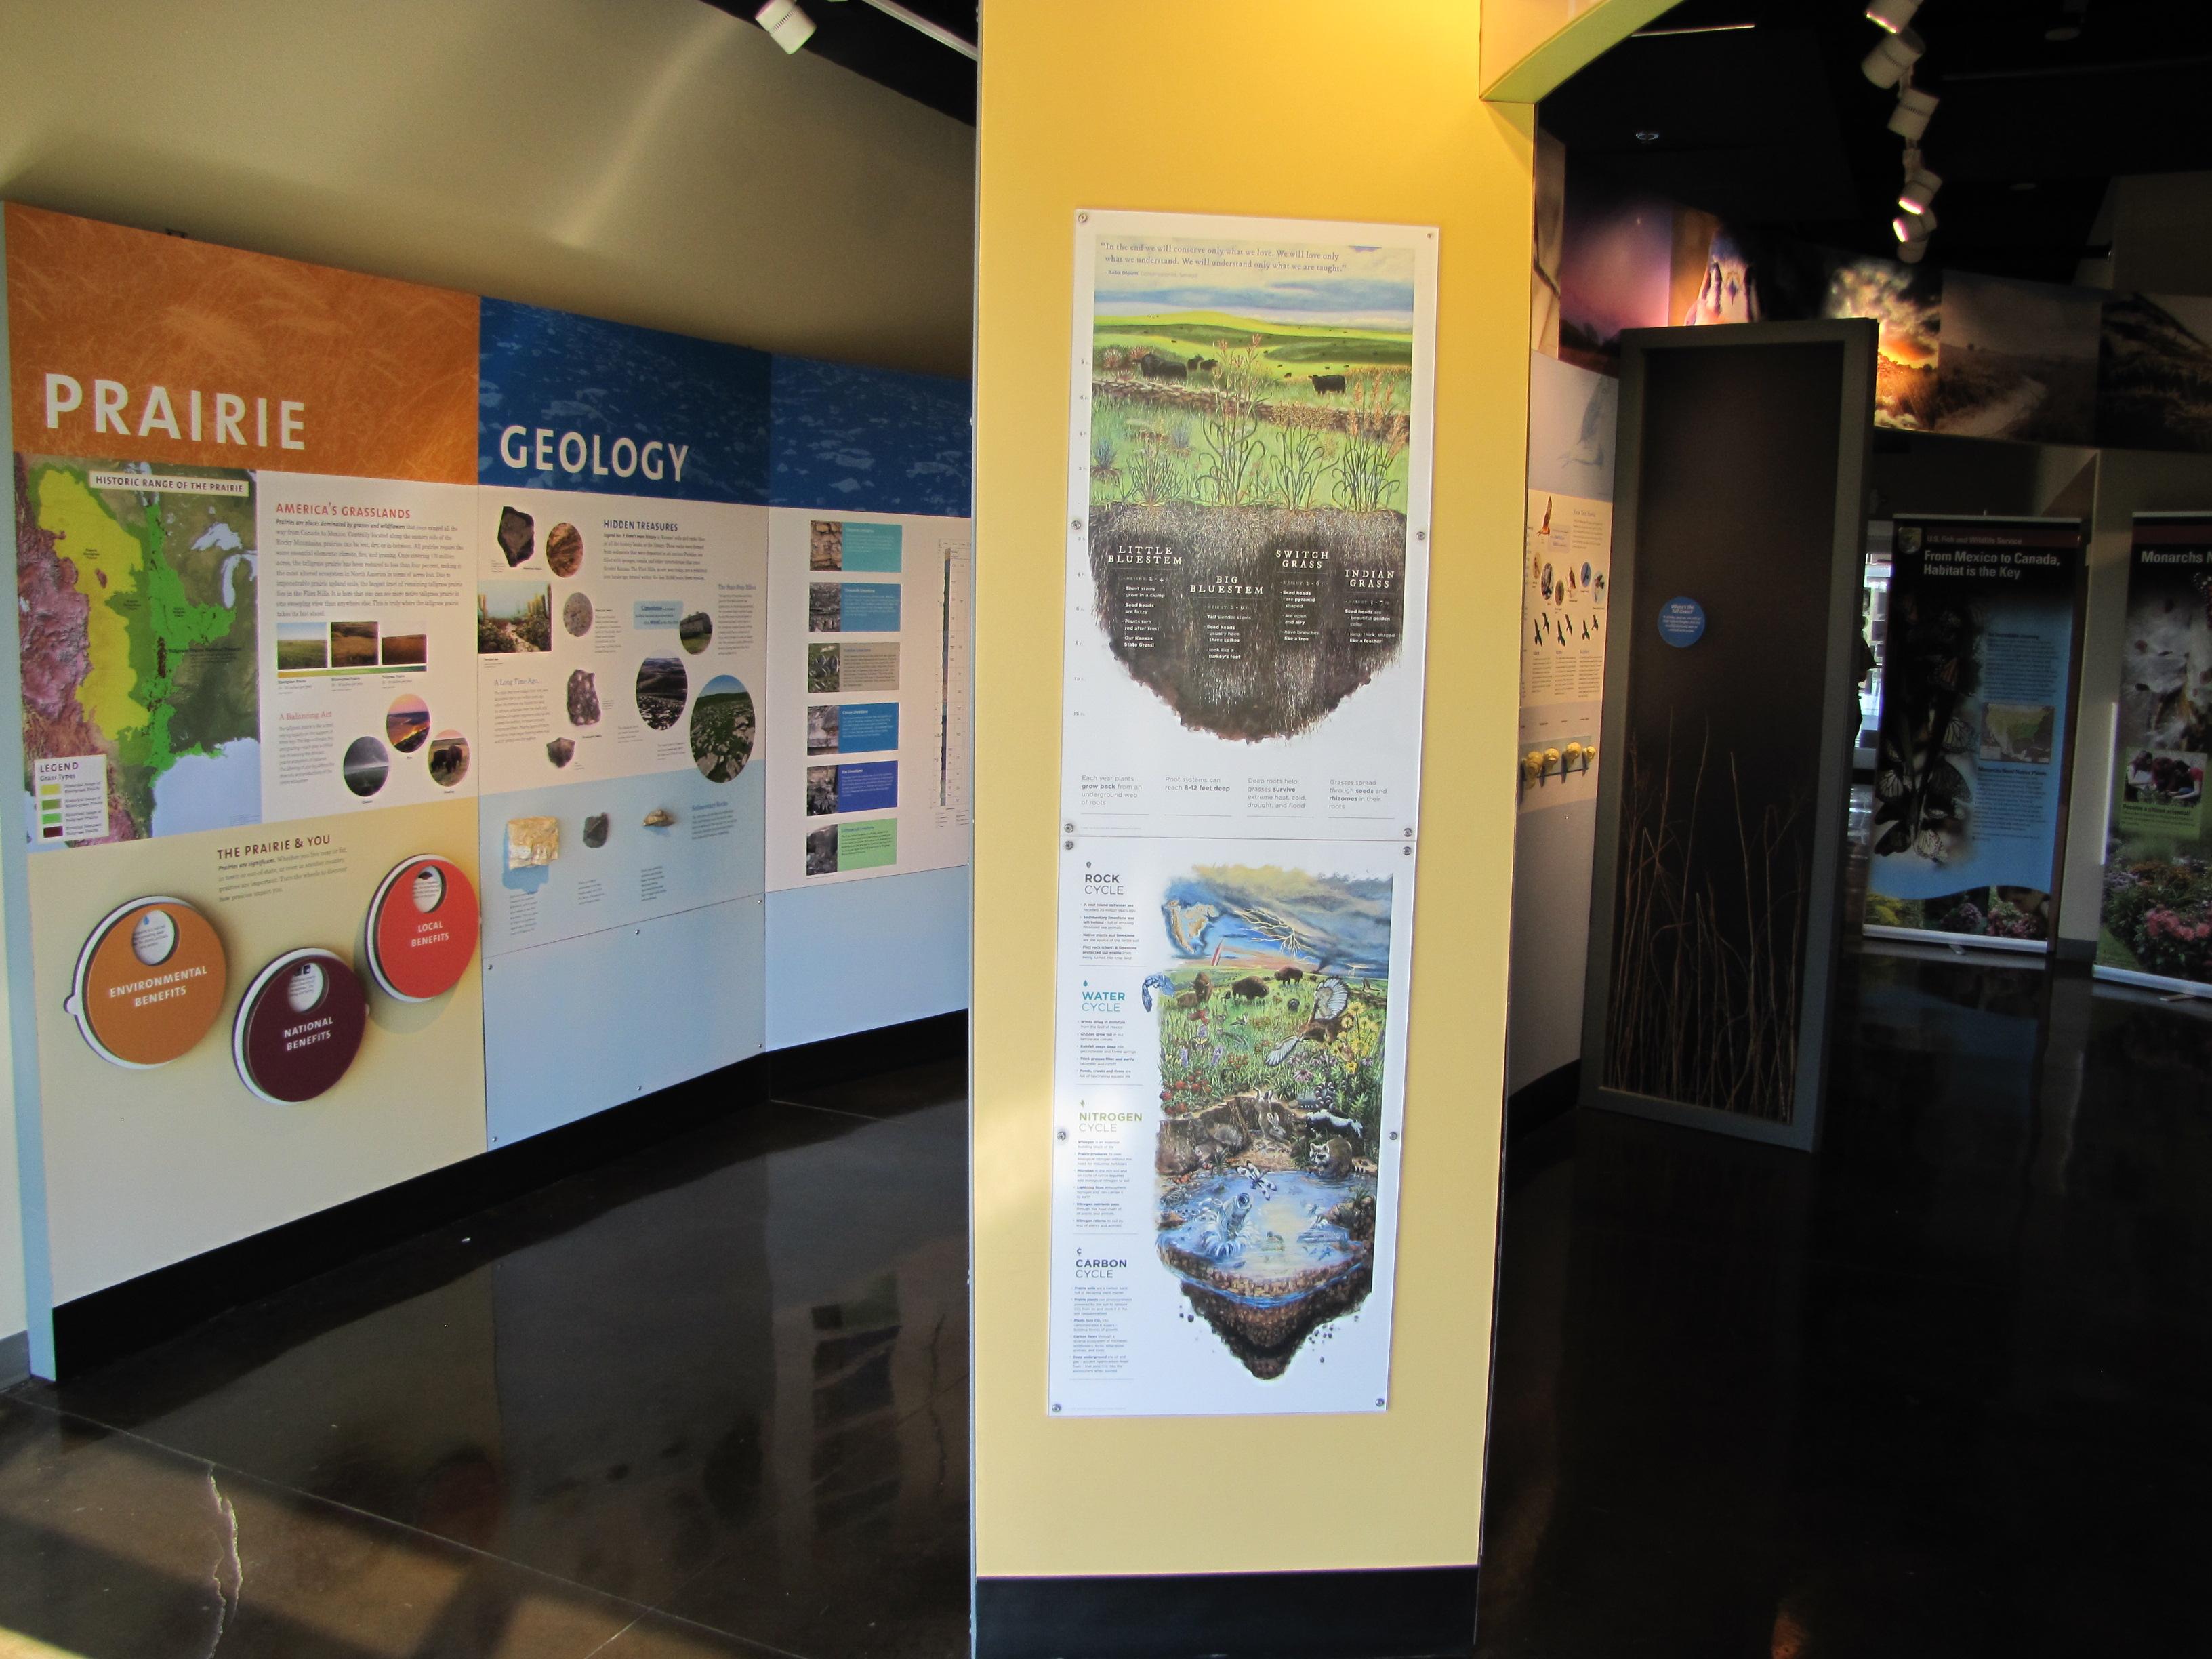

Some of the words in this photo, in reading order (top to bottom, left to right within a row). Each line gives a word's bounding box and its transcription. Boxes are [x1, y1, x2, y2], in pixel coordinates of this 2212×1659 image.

[1101, 241, 1115, 251] "In
[1157, 245, 1172, 253] will
[1207, 247, 1225, 257] only
[1226, 247, 1242, 255] what
[1257, 249, 1275, 257] love.
[1322, 251, 1339, 261] only
[1136, 255, 1179, 264] understand.
[1212, 258, 1251, 268] understand
[1254, 260, 1270, 270] only
[1272, 261, 1289, 269] what
[1317, 262, 1346, 273] taught."
[45, 373, 306, 450] PRAIRIE
[500, 425, 689, 482] GEOLOGY
[96, 476, 140, 487] HISTORIC
[142, 478, 173, 489] RANGE
[176, 480, 188, 489] OF
[191, 481, 207, 491] THE
[210, 483, 244, 492] PRAIRIE
[276, 502, 337, 516] AMERICA'S
[342, 506, 411, 519] GRASSLANDS
[603, 520, 635, 530] HIDDEN
[637, 520, 678, 531] TREASURES
[1118, 545, 1172, 554] LITTLE
[1275, 550, 1328, 560] SWITCH
[1108, 554, 1182, 565] BLUESTEM
[1925, 550, 1952, 561] From
[1954, 551, 1998, 563] Mexico
[2001, 553, 2011, 563] to
[2014, 552, 2060, 567] Canada,
[2142, 551, 2203, 563] Monarchs
[1282, 560, 1323, 569] GRASS
[1345, 569, 1395, 579] INDIAN
[1924, 564, 1963, 576] Habitat
[1967, 565, 1976, 576] is
[1979, 565, 1996, 577] the
[2000, 567, 2021, 580] Key
[1216, 575, 1238, 584] BIG
[1350, 579, 1389, 588] GRASS
[1190, 584, 1263, 594] BLUESTEM
[321, 710, 332, 718] Act
[40, 762, 79, 773] LEGEND
[58, 773, 76, 781] Types
[217, 847, 240, 859] THE
[245, 840, 290, 855] PRAIRIE
[295, 838, 304, 848] &
[308, 834, 331, 846] YOU
[1084, 874, 1120, 884] ROCK
[1084, 885, 1124, 895] CYCLE
[418, 920, 443, 933] LOCAL
[411, 933, 449, 947] BENEFITS
[110, 966, 207, 998] ENVIRONMENTAL
[135, 985, 187, 1007] BENEFITS
[1082, 991, 1126, 1001] WATER
[1082, 1003, 1121, 1012] CYCLE
[284, 1017, 333, 1038] NATIONAL
[287, 1030, 331, 1052] BENEFITS
[1079, 1112, 1143, 1122] NITROGEN
[1079, 1123, 1117, 1132] CYCLE
[1075, 1259, 1128, 1268] CARBON
[1075, 1269, 1113, 1279] CYCLE
